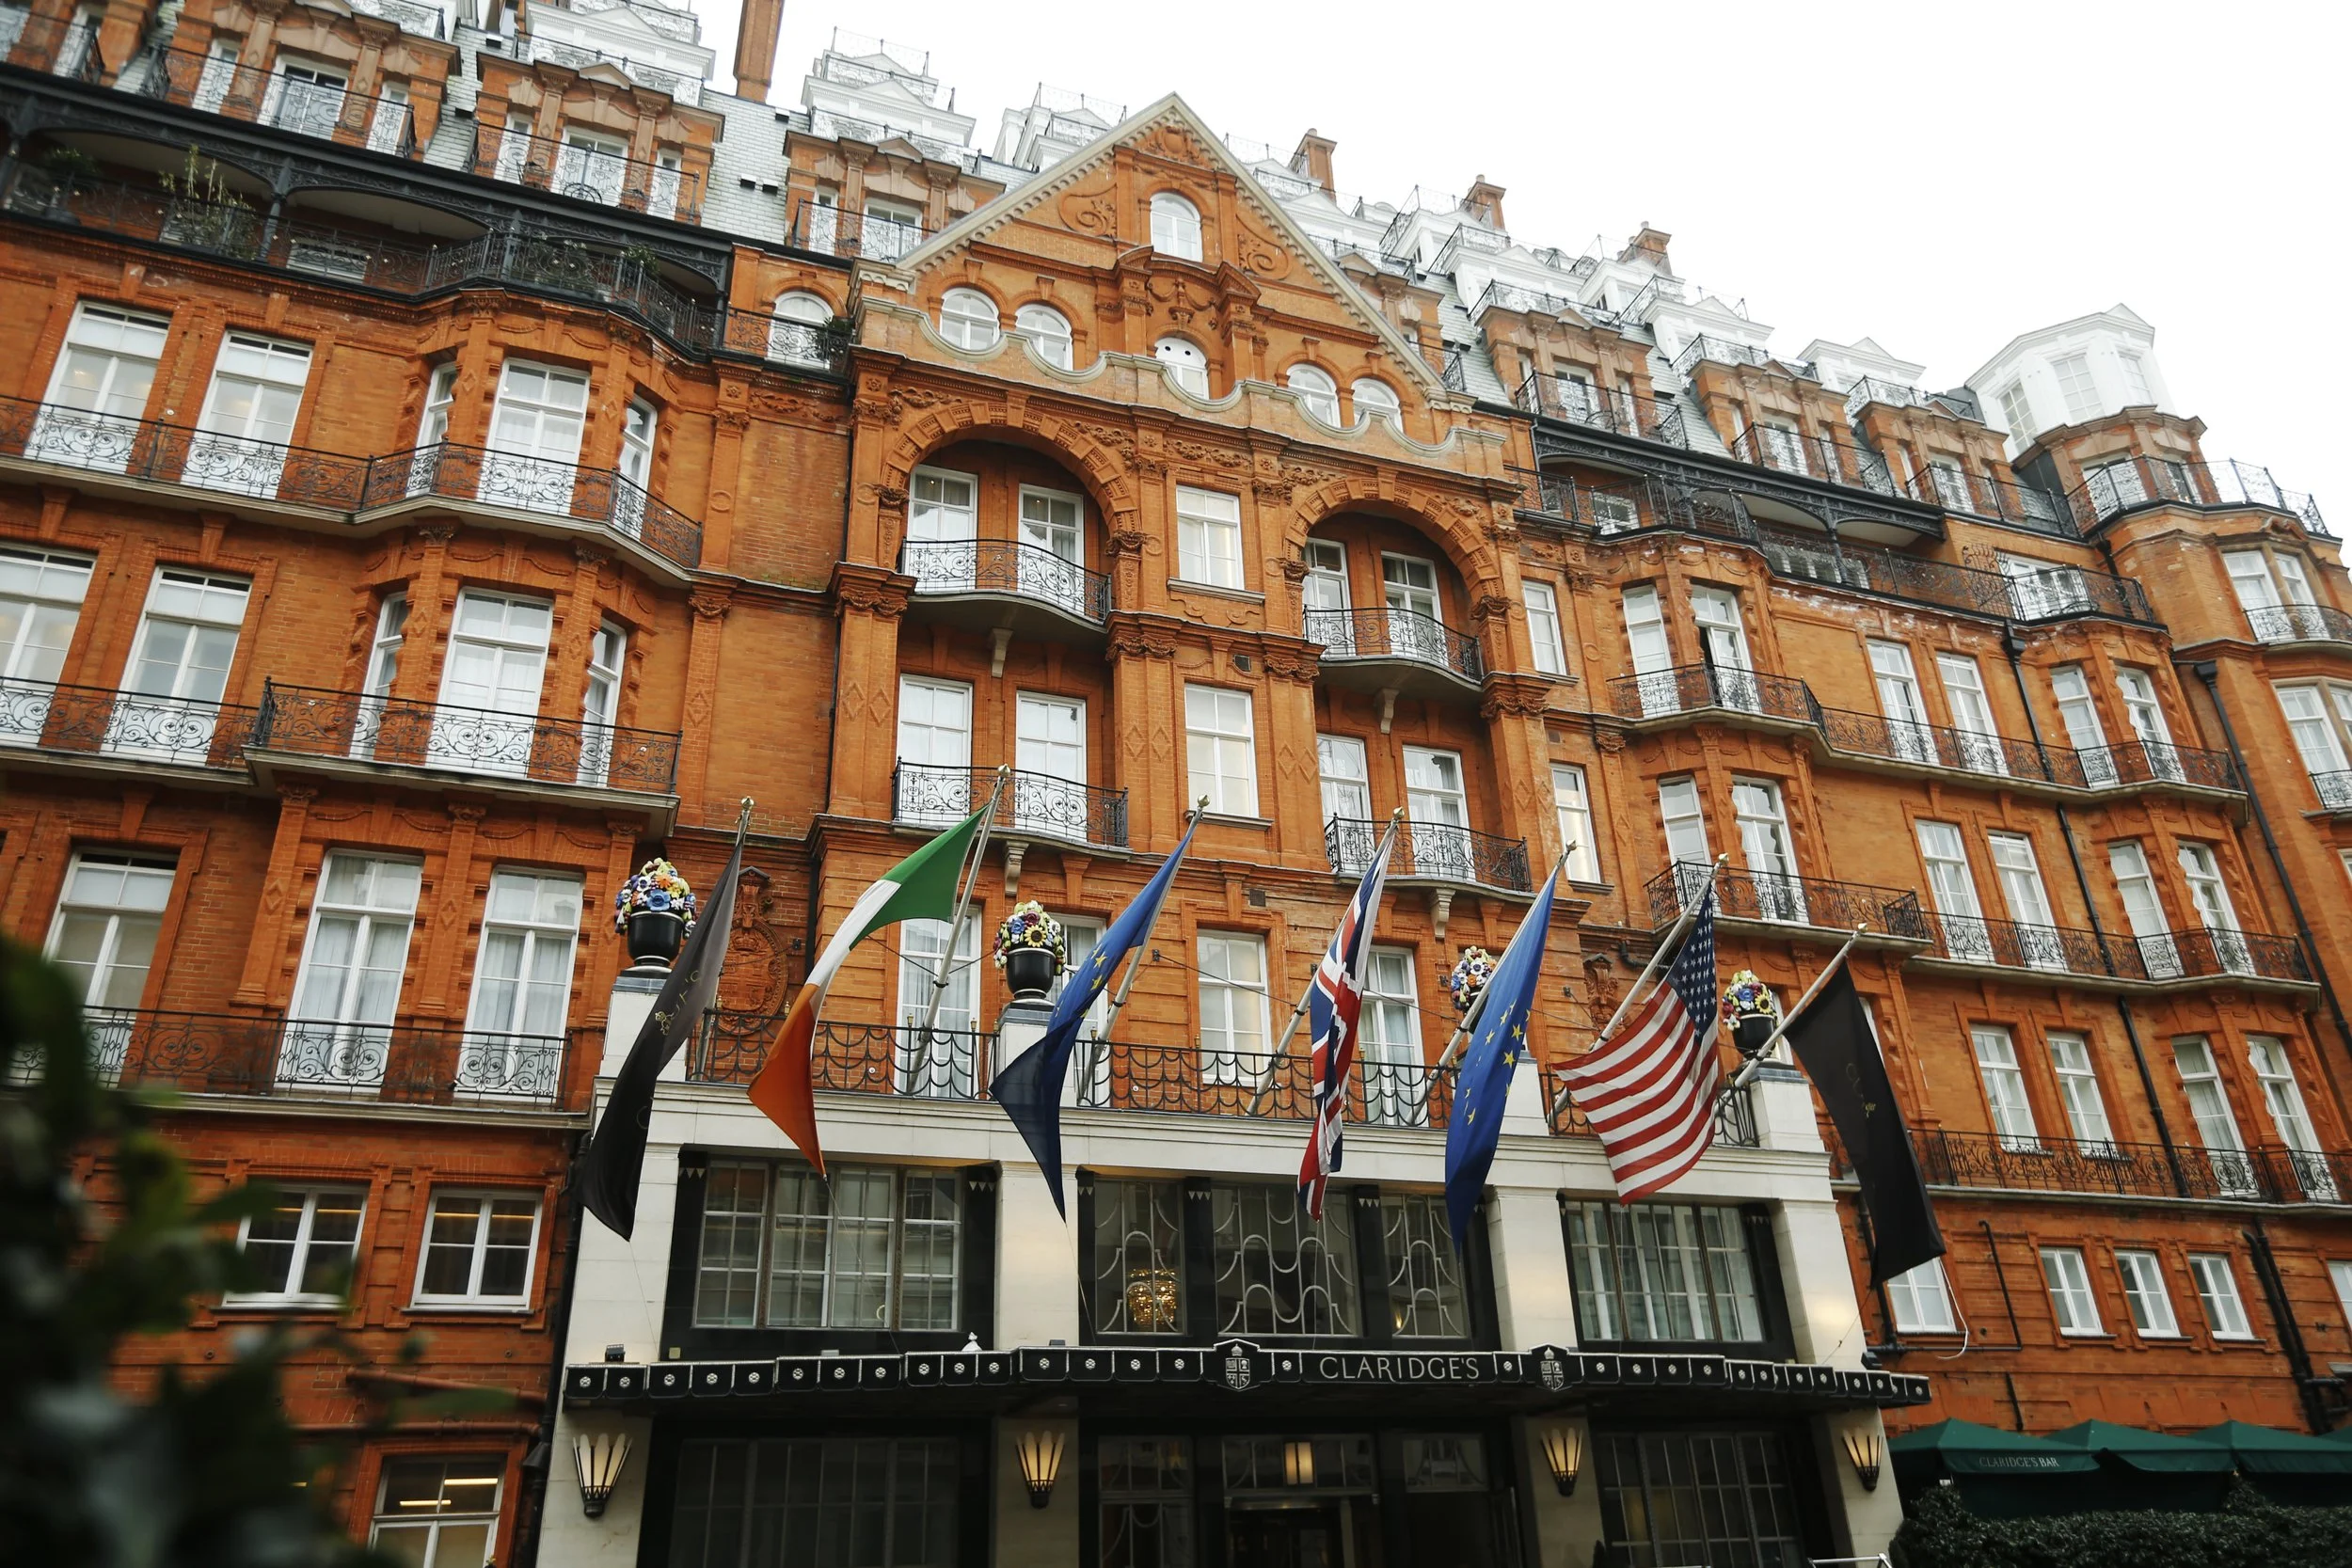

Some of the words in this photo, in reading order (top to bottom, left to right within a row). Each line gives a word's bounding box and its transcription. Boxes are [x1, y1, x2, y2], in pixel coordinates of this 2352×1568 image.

[1319, 1356, 1480, 1381] CLARIDGE'S
[1979, 1456, 2039, 1467] CLARIDGE'S
[2038, 1456, 2060, 1467] BAR
